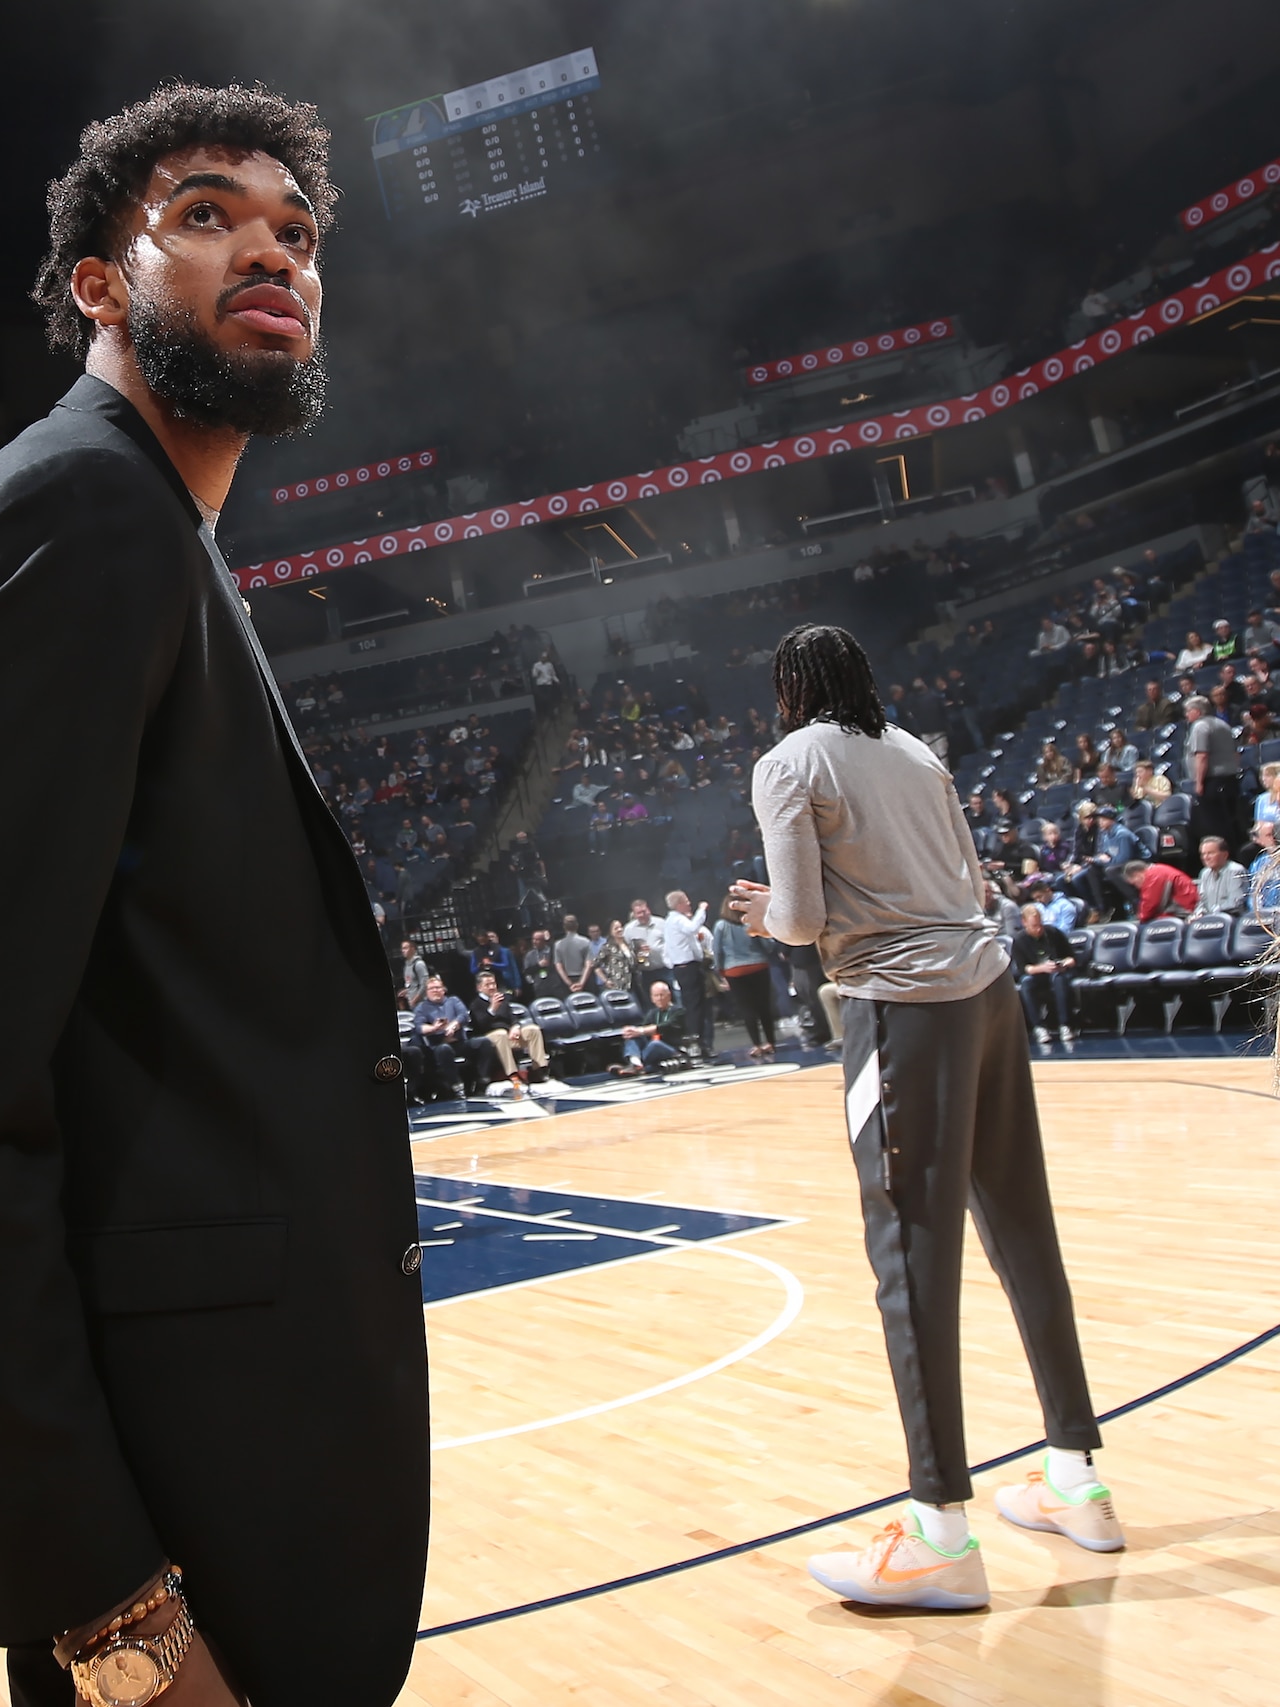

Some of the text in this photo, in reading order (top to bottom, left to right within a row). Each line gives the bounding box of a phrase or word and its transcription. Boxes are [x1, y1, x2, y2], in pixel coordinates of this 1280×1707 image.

[481, 176, 546, 206] Treasure Island
[358, 640, 376, 651] 104
